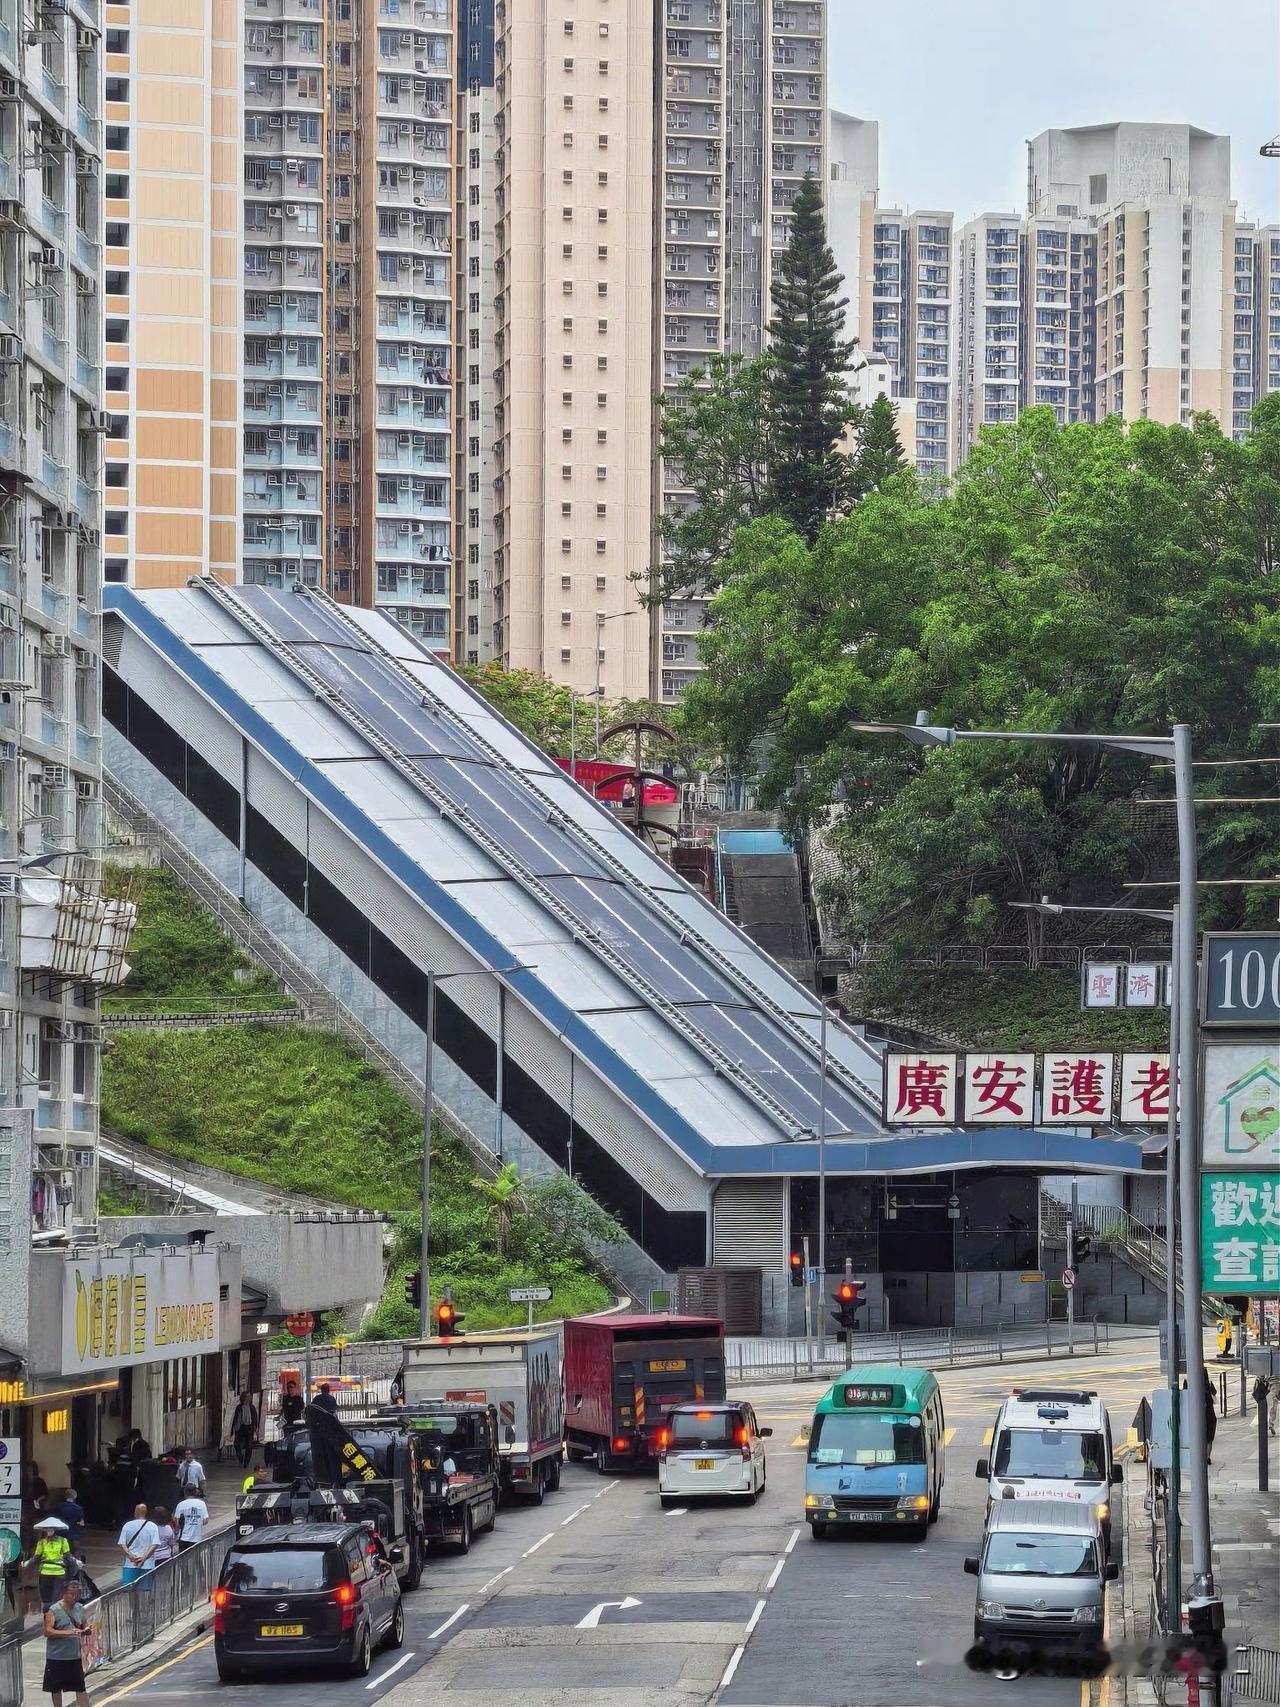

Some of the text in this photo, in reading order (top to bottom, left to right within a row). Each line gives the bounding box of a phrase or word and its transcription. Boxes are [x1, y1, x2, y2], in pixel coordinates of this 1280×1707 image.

[1092, 974, 1172, 998] 聖濟
[893, 1059, 1180, 1117] 廣安護老
